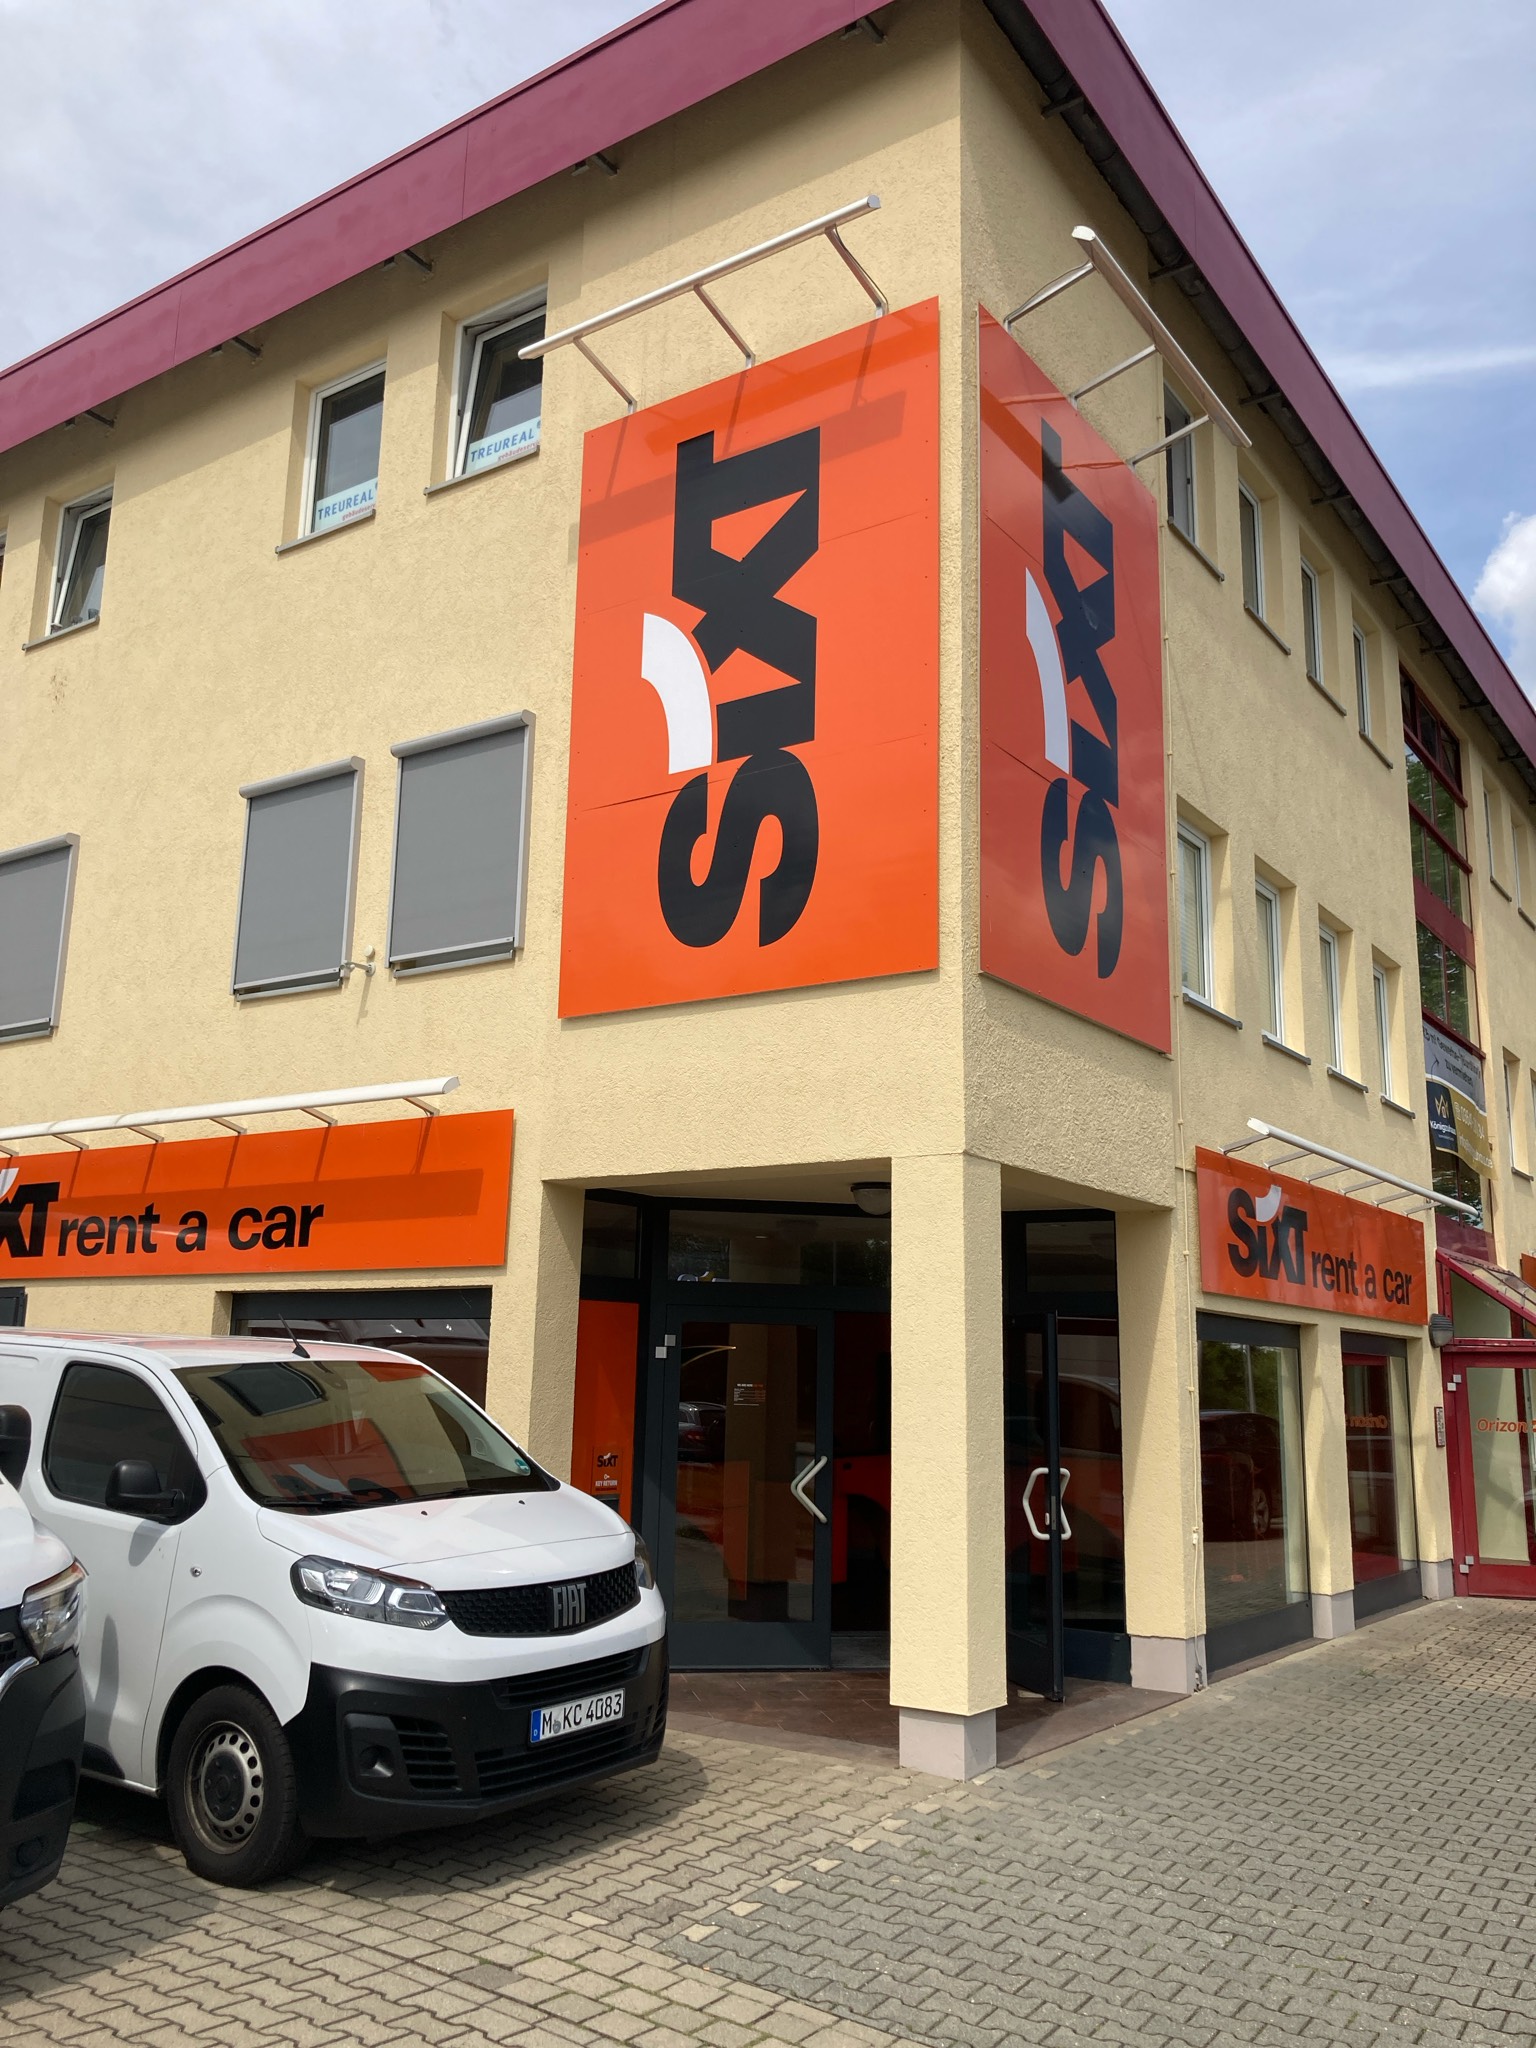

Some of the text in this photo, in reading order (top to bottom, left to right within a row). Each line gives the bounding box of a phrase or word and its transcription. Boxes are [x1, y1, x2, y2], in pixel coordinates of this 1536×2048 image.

[470, 428, 535, 462] TREUREAL
[318, 489, 374, 521] TREUREAL
[57, 1202, 160, 1257] rent
[175, 1210, 209, 1254] a
[228, 1202, 324, 1251] car
[1311, 1251, 1358, 1296] rent
[1364, 1264, 1377, 1299] a
[1383, 1268, 1412, 1305] car
[1477, 1417, 1528, 1433] Orizon
[552, 1582, 587, 1629] FIAT
[542, 1693, 623, 1737] M KC 4083
